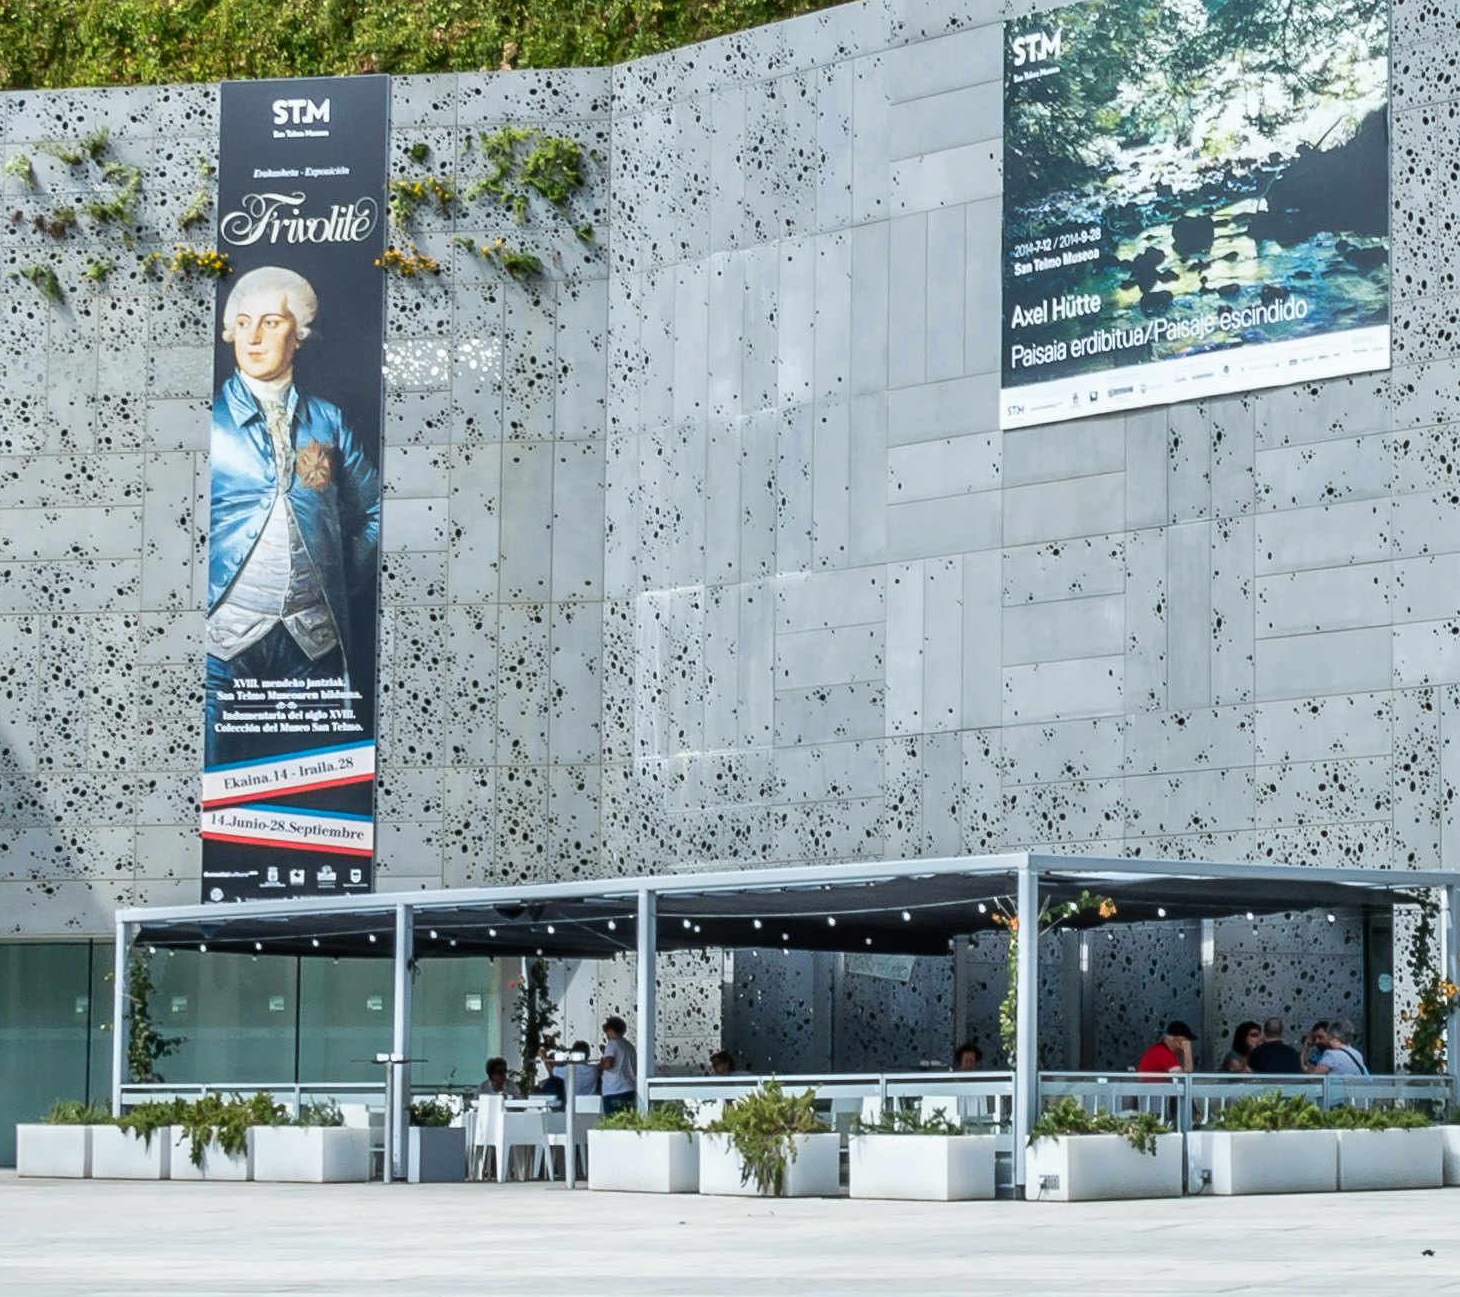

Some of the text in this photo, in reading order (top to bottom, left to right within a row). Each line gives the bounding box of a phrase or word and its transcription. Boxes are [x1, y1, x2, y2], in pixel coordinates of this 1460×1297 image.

[1013, 27, 1062, 66] STM
[272, 98, 330, 125] STM
[1059, 227, 1101, 249] 2014-9-28
[1014, 248, 1100, 276] San Telmo Museoa
[1011, 293, 1101, 329] Axel Hütte
[1011, 339, 1067, 369] Paisaia
[1220, 296, 1307, 331] escindido
[261, 678, 305, 688] mendeko
[216, 691, 235, 701] San
[236, 691, 266, 701] Telmo
[214, 722, 363, 733] Colección del Museo San Telmo.
[222, 709, 356, 722] Indumentaria del siglo XVIII.
